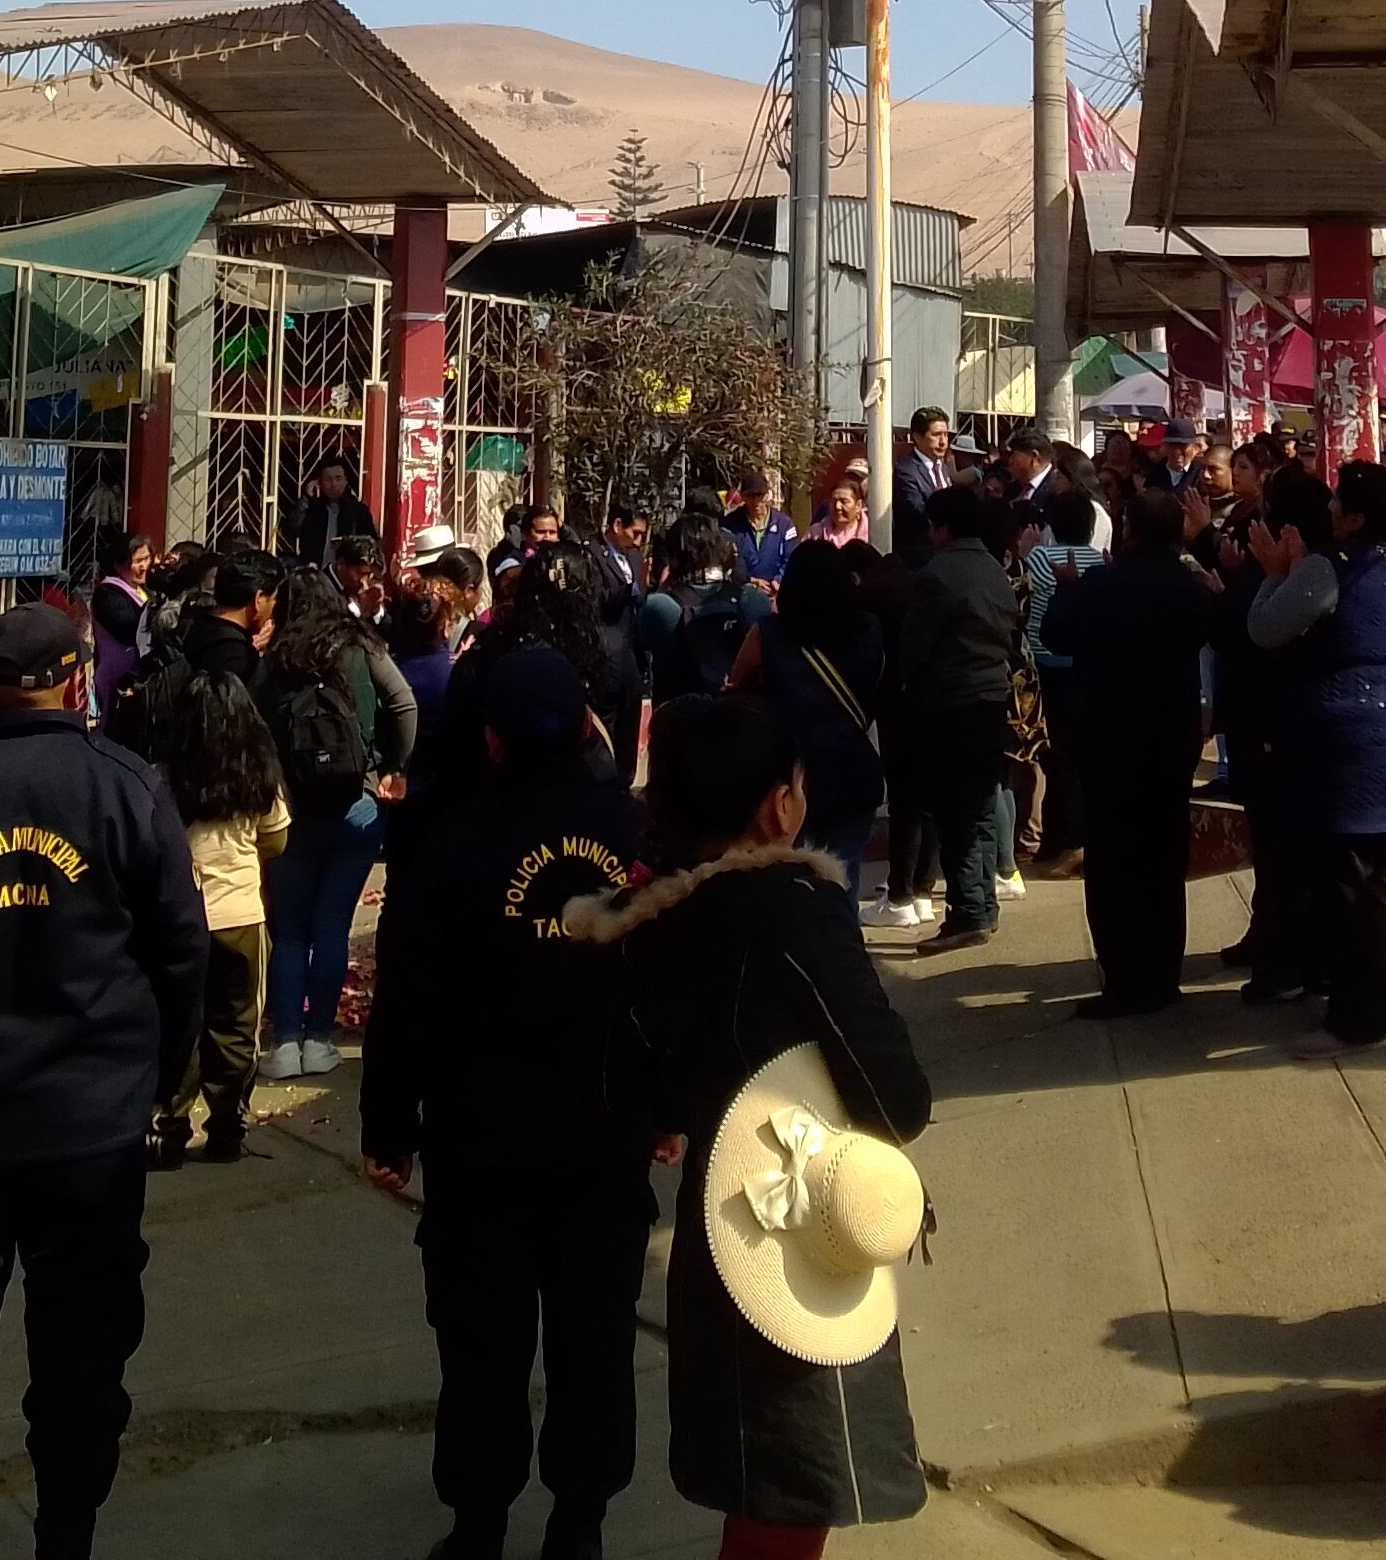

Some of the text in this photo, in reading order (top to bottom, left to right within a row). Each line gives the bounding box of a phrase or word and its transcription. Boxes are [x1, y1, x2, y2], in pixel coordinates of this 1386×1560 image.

[35, 443, 66, 468] BOTAR
[8, 475, 16, 499] Y
[17, 475, 66, 500] DESMONTE
[12, 826, 90, 883] MUNICIPAL
[505, 835, 628, 917] POLICIA MUNICIP
[532, 917, 573, 939] TAC
